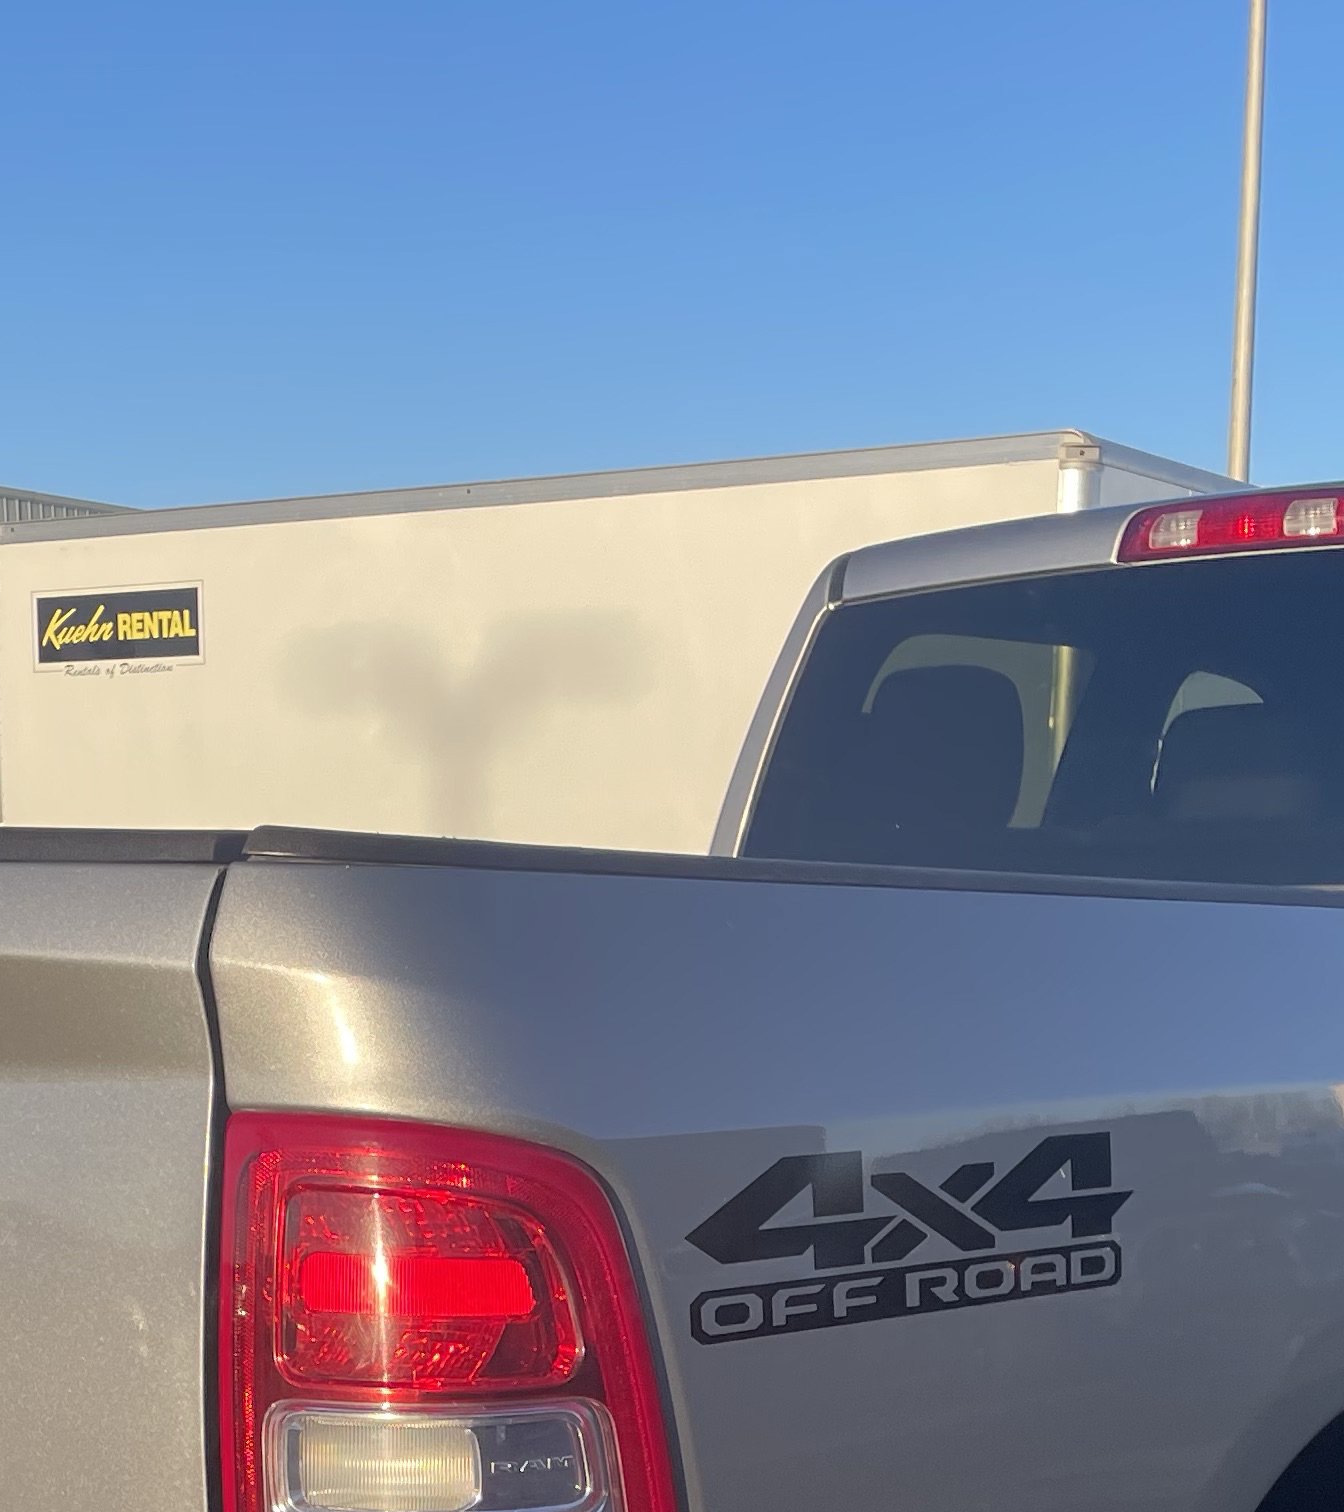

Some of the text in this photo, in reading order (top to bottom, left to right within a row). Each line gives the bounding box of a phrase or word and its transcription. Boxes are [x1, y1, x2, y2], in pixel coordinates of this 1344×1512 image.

[42, 604, 196, 650] Kuehn RENTAL
[105, 664, 116, 679] of
[119, 661, 174, 676] Distinction
[700, 1245, 1117, 1337] OFF ROAD
